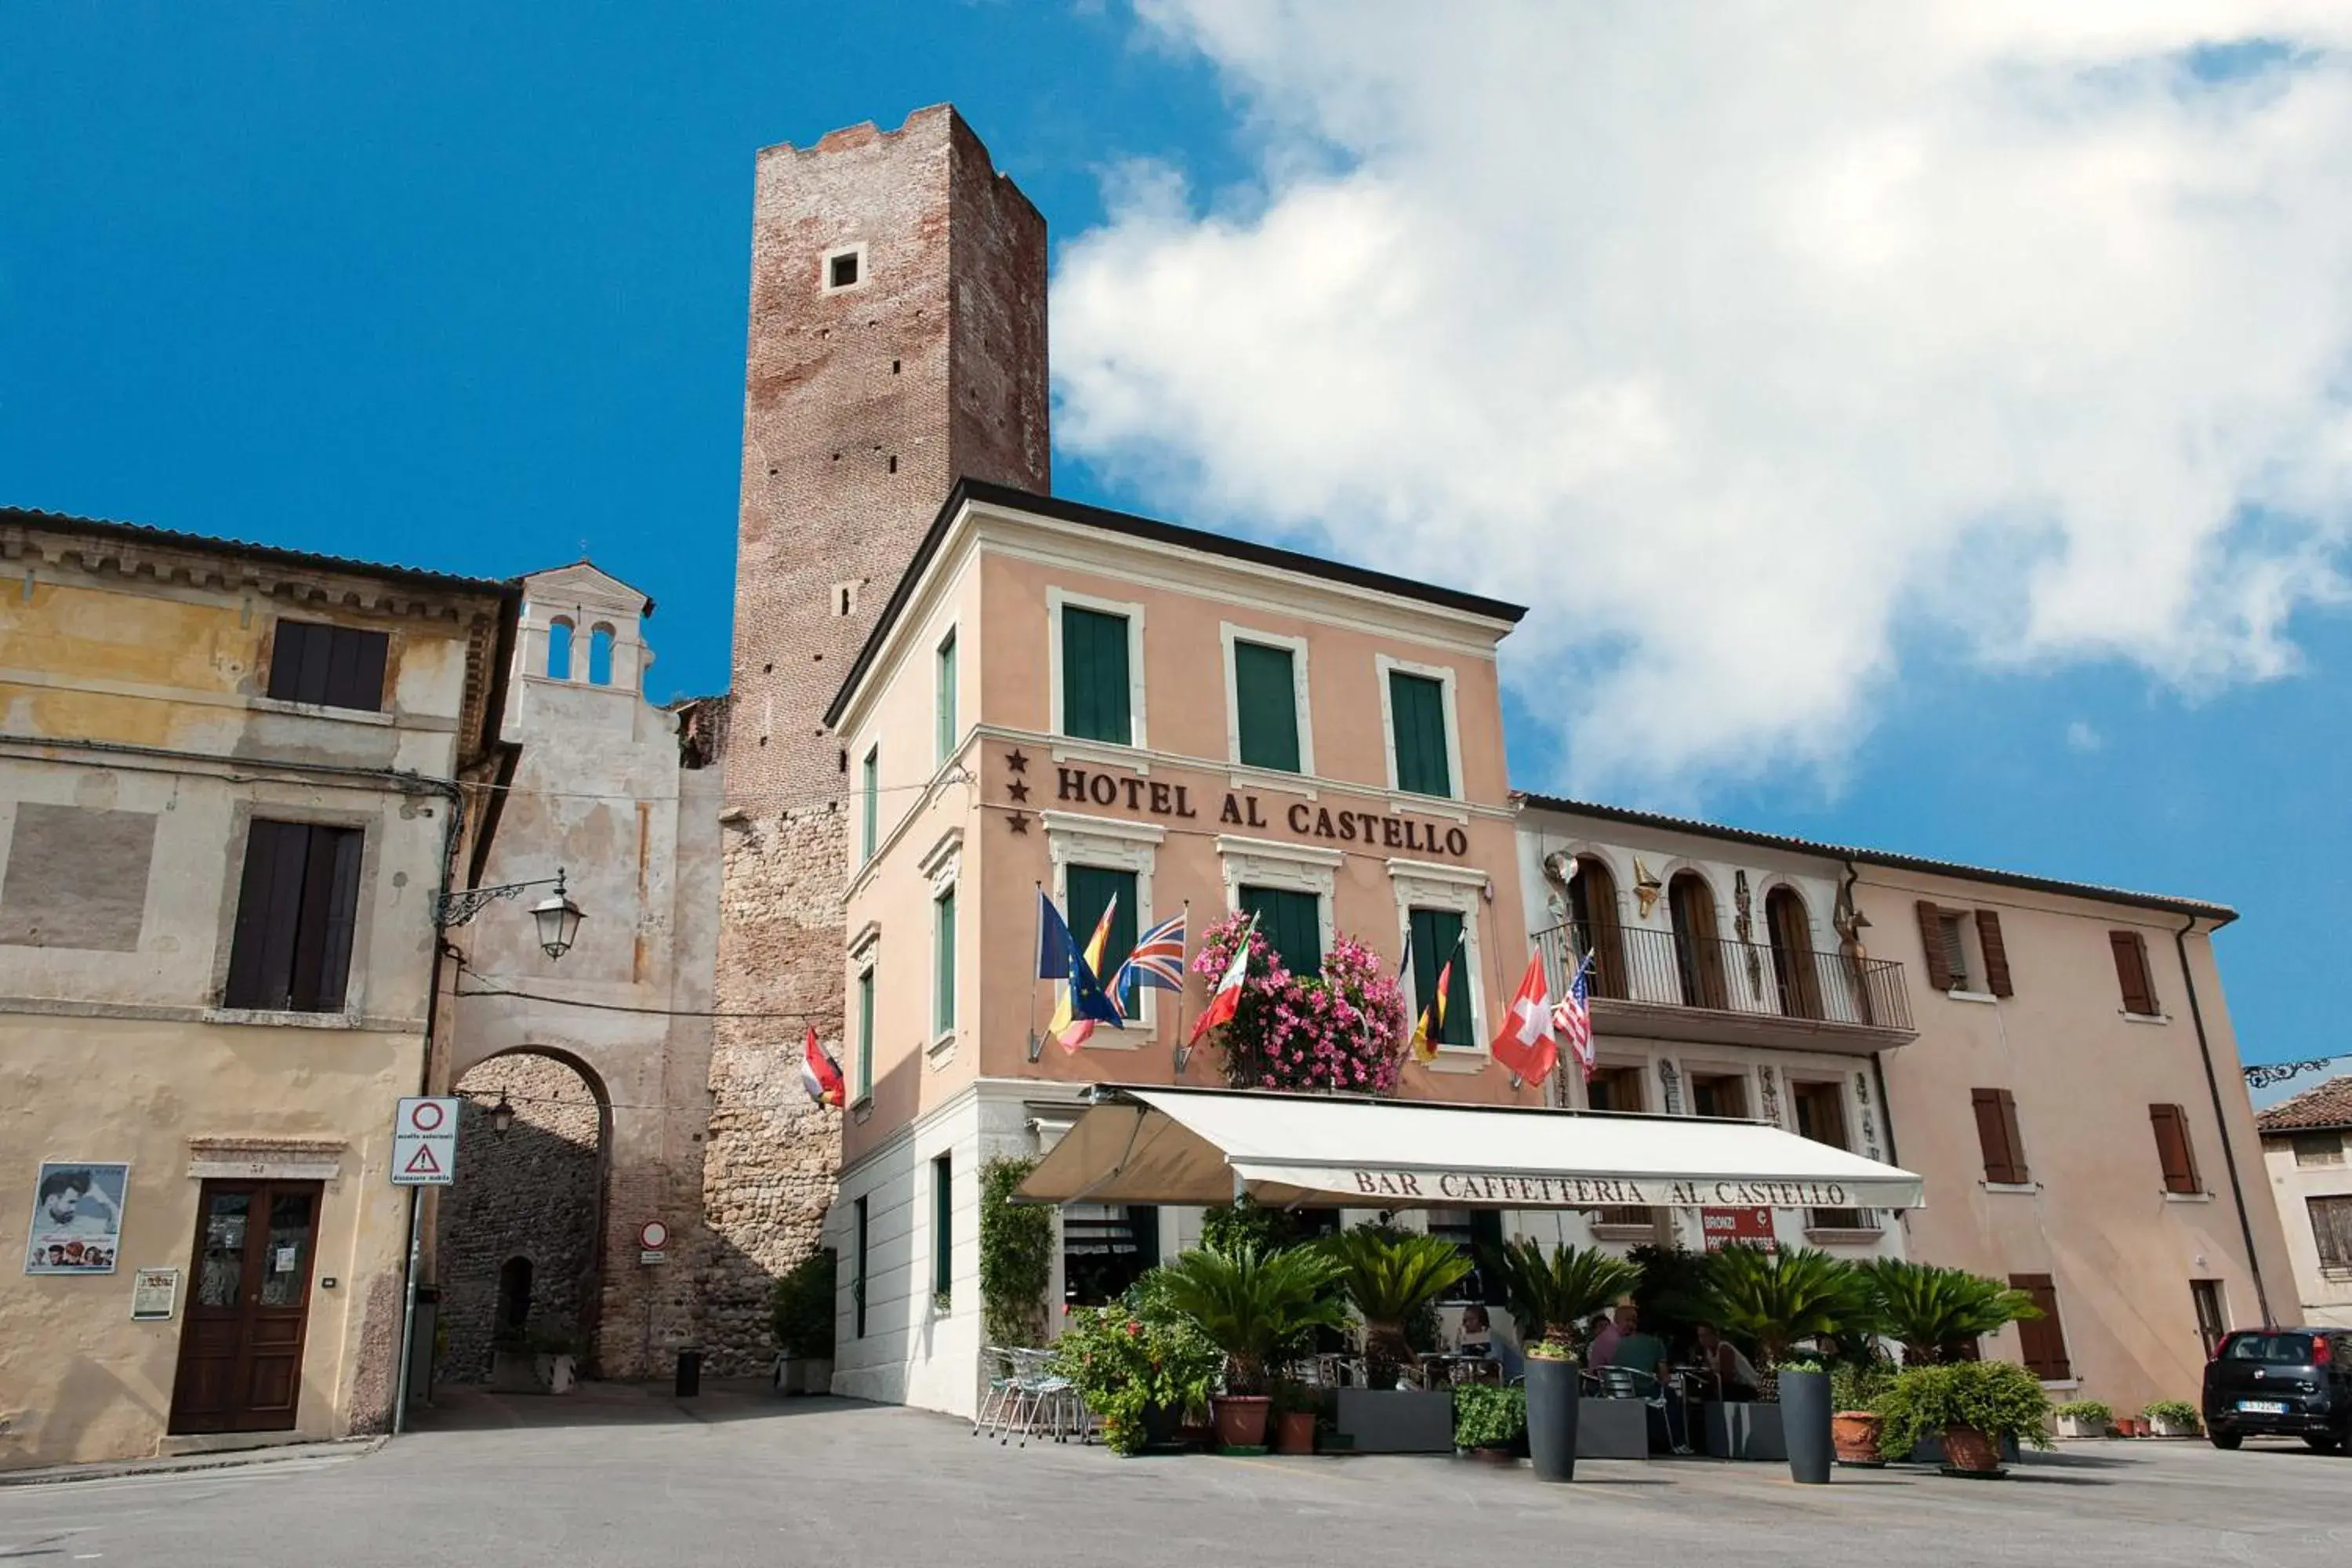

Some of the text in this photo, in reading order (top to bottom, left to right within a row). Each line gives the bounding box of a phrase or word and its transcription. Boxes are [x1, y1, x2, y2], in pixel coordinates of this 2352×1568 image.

[1058, 768, 1468, 856] HOTEL AL CASTELLO
[1354, 1171, 1846, 1205] BAR CAFFETTERIA AL CASTELLO
